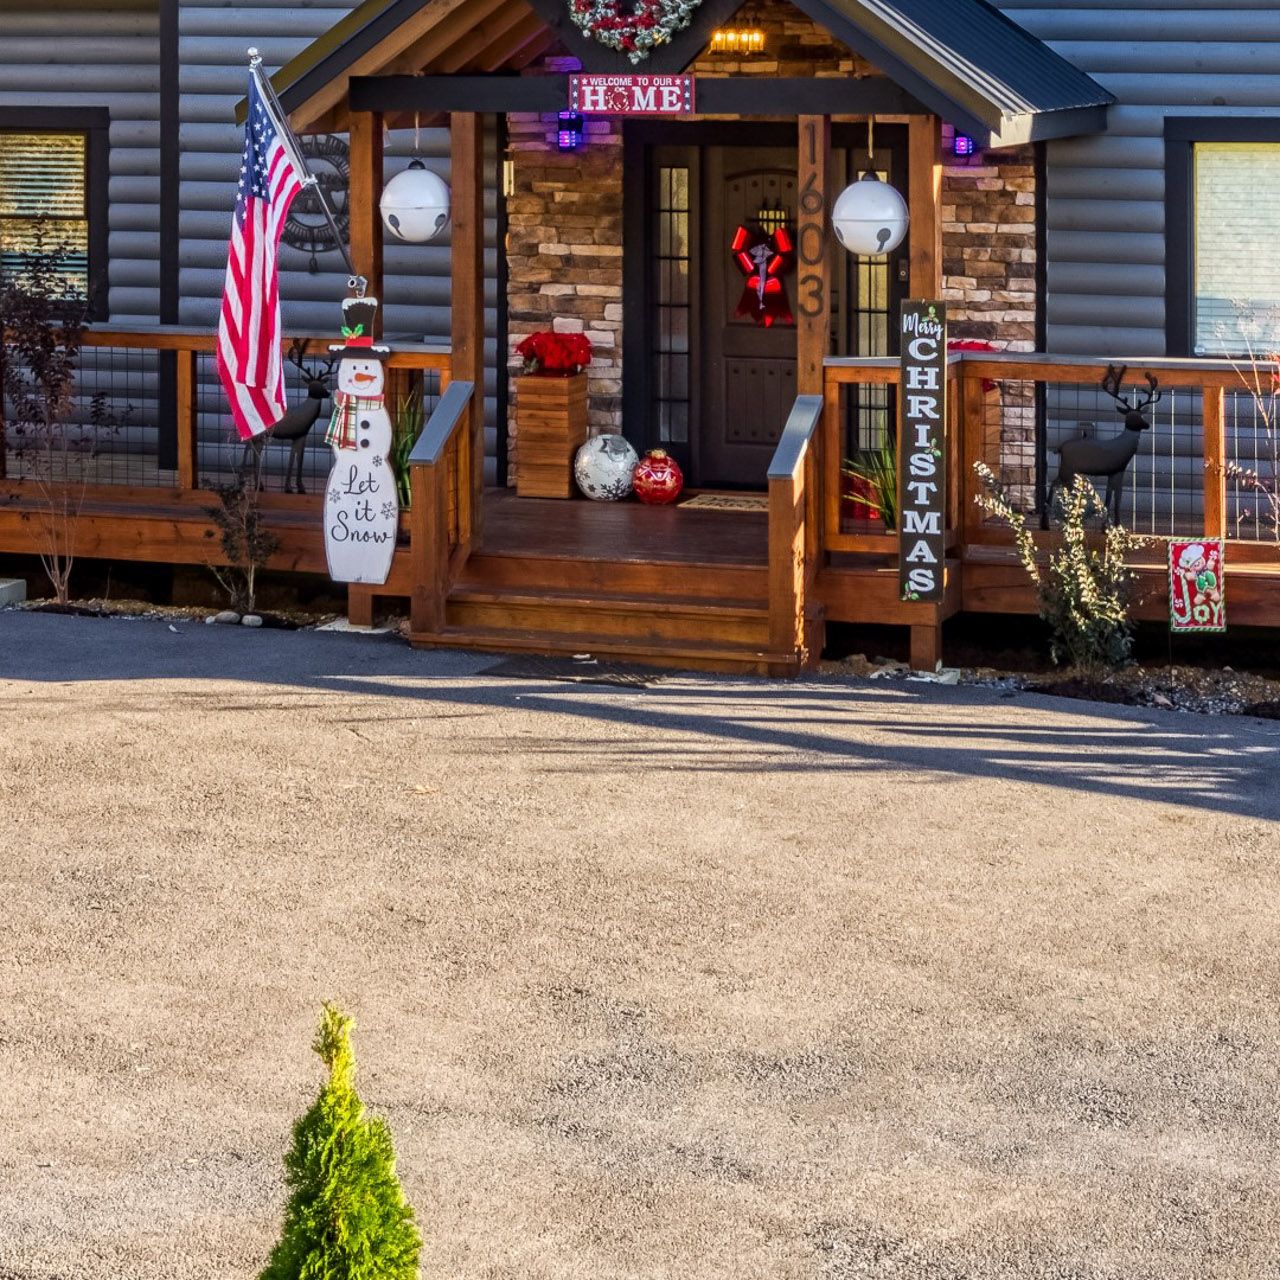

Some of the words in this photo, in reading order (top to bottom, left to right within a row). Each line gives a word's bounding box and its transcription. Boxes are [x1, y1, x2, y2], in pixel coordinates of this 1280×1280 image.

[589, 77, 633, 87] WELCOME
[637, 77, 649, 86] TO
[653, 77, 673, 86] OUR
[581, 86, 682, 111] HOME
[798, 122, 824, 317] 1603
[903, 312, 944, 340] Merry
[341, 464, 380, 495] Let
[903, 338, 941, 592] CHRISTMAS
[355, 499, 377, 522] it
[331, 510, 393, 544] Snow
[1172, 568, 1223, 625] JOY
